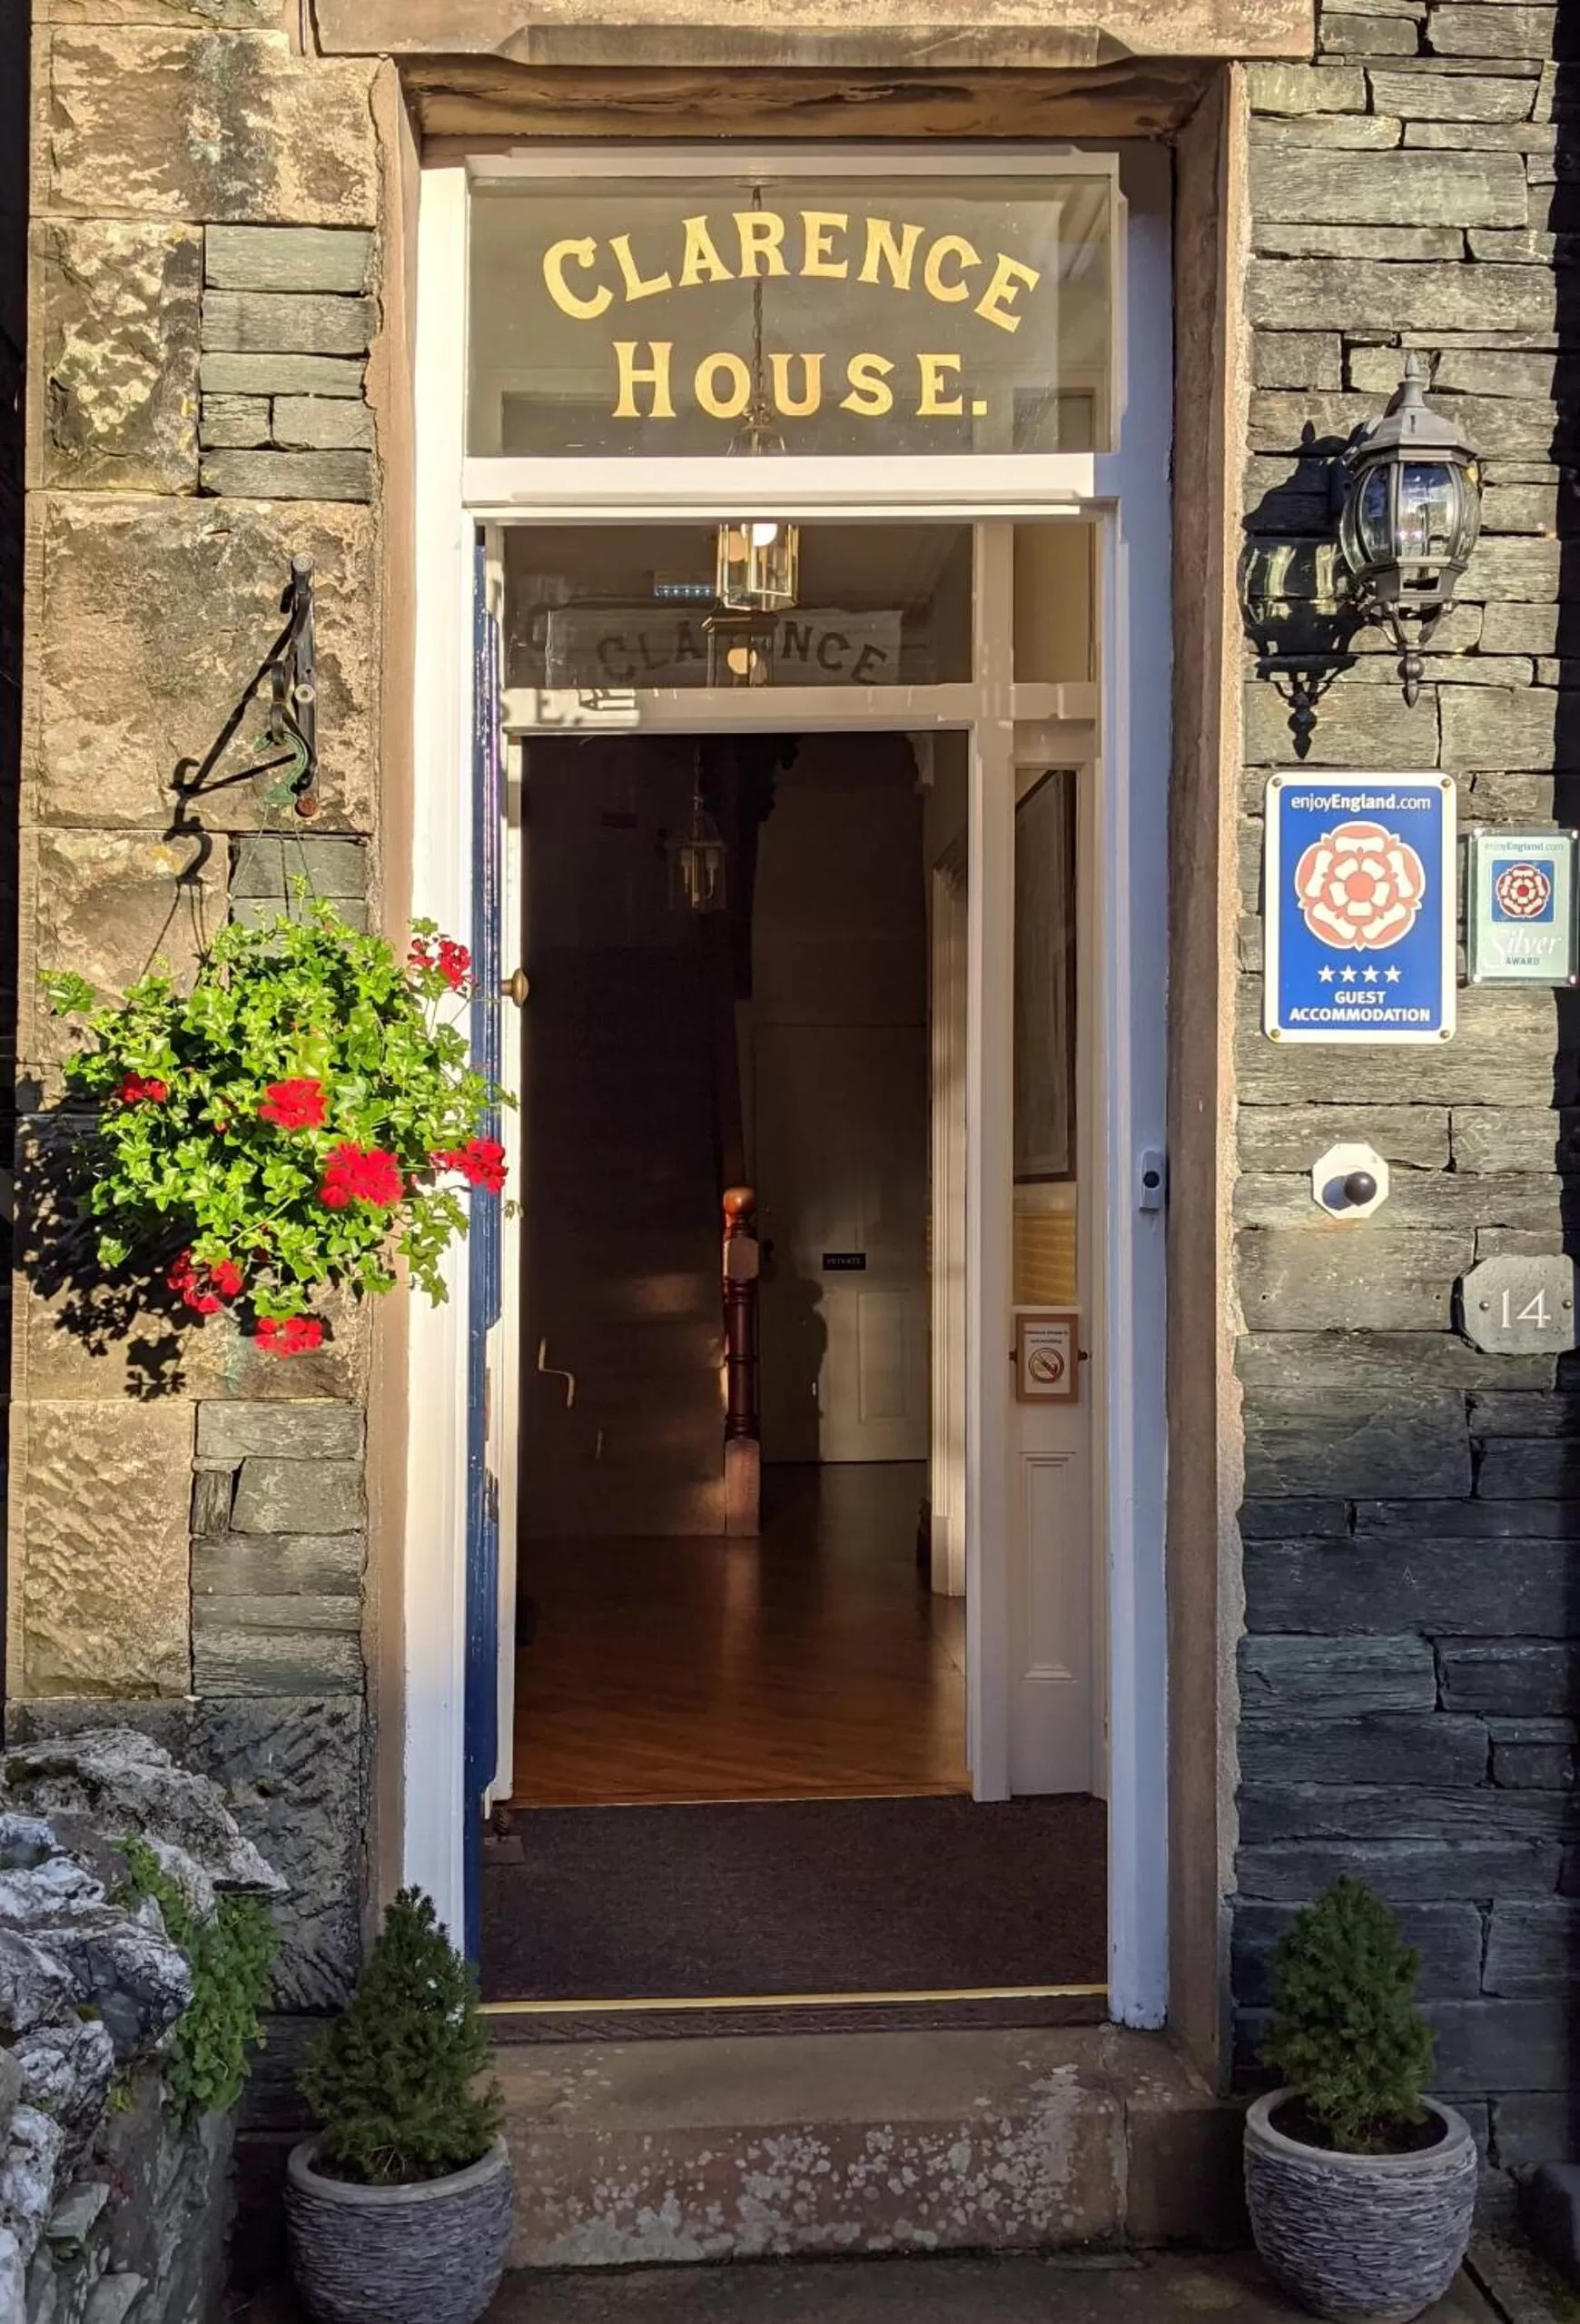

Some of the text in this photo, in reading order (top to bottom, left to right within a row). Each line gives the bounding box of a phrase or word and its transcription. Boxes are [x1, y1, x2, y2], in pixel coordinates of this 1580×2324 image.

[543, 210, 1041, 332] CLARENCE
[611, 341, 988, 420] HOUSE.
[1290, 793, 1432, 813] enjoyEngland.com
[1486, 927, 1563, 969] Silver
[1506, 956, 1541, 965] AWARD
[1334, 990, 1387, 1005] GUEST
[1289, 1007, 1431, 1023] ACCOMMODATION
[1501, 1288, 1552, 1330] 14
